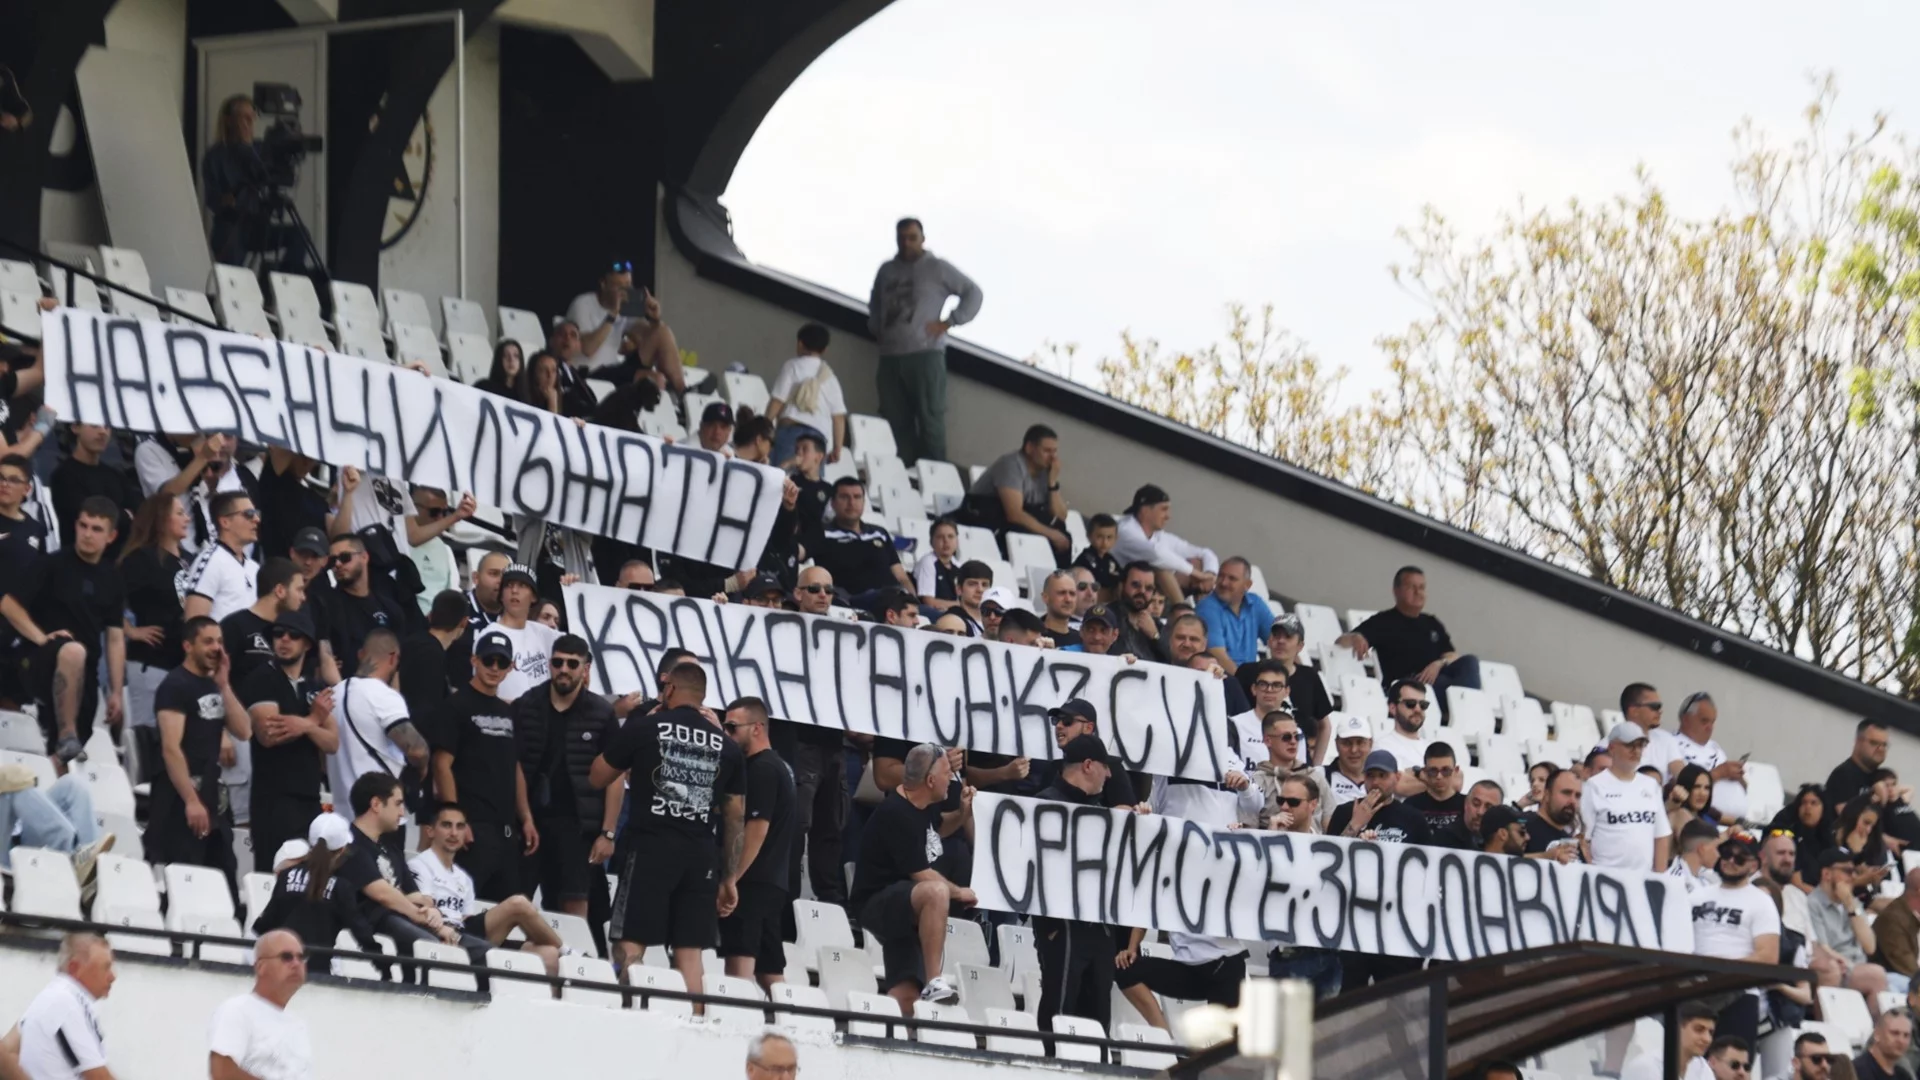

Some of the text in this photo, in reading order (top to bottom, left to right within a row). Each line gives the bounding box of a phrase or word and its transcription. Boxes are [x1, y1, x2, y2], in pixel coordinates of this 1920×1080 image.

[658, 722, 723, 751] 2006
[811, 909, 820, 919] 34
[1015, 934, 1023, 944] 31
[832, 951, 841, 962] 35
[970, 969, 978, 981] 33
